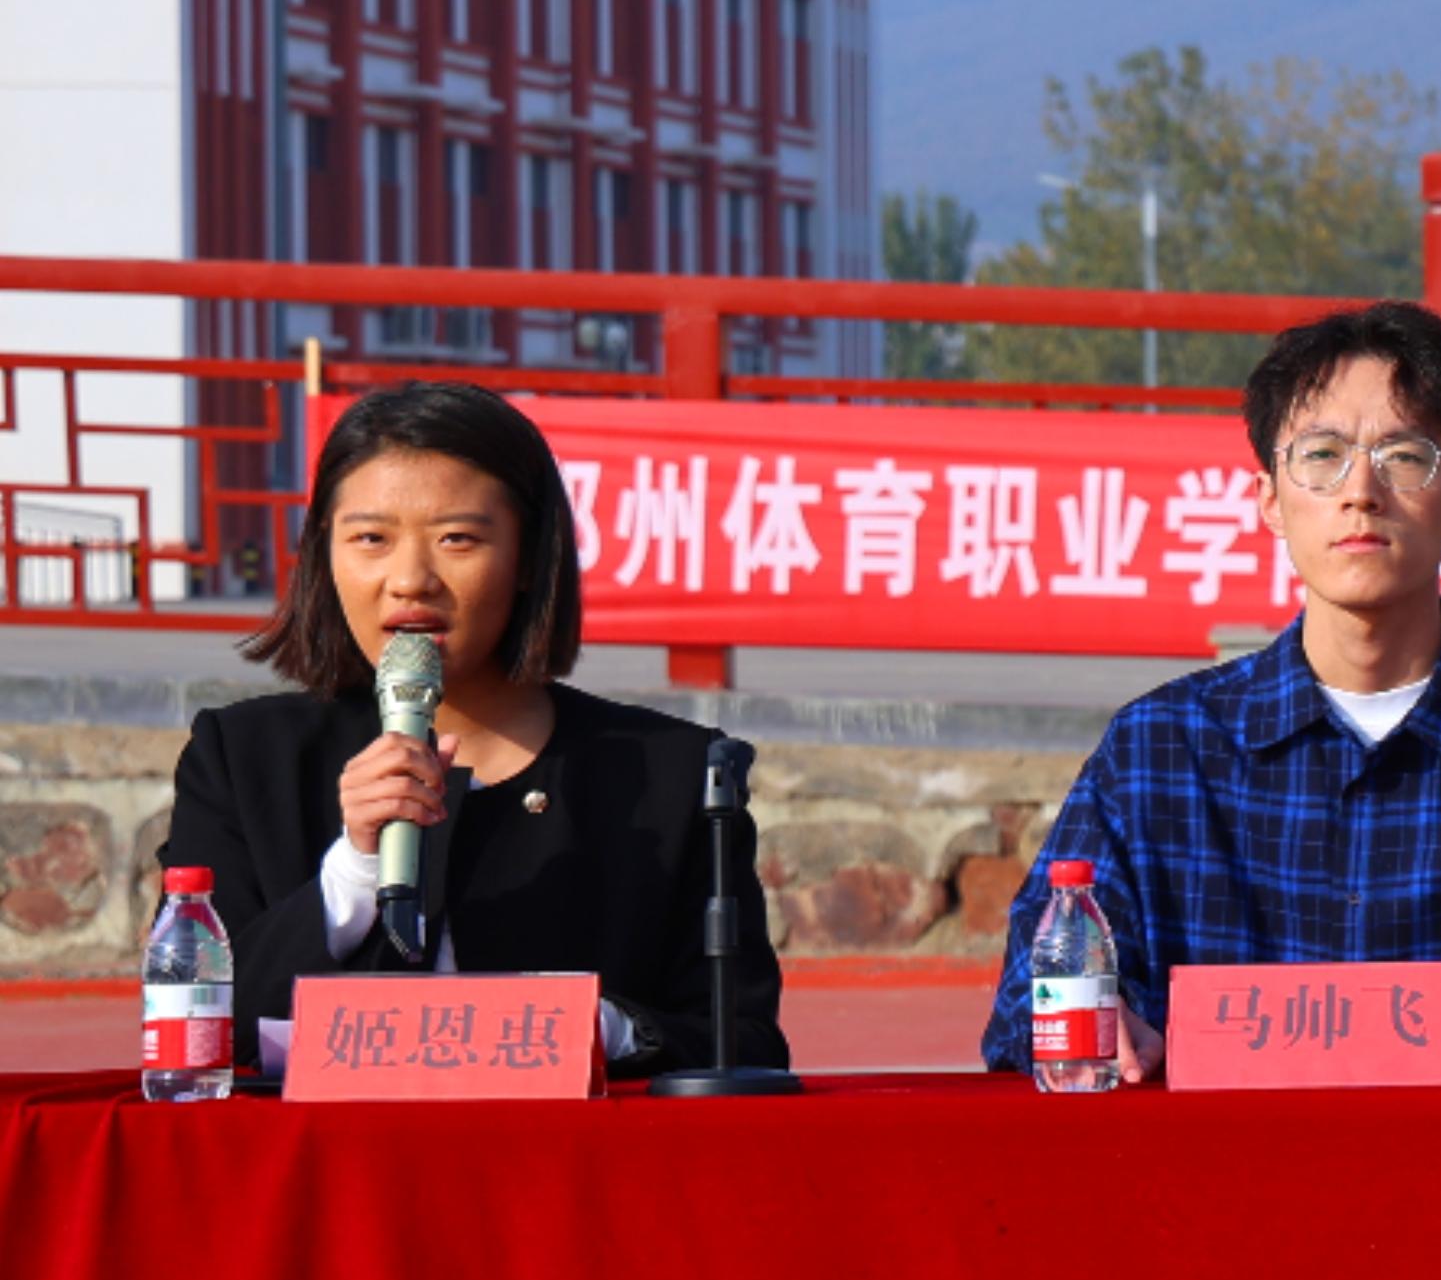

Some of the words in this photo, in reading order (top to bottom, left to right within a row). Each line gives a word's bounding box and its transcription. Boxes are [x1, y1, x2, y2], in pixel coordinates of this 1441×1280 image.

[320, 1003, 566, 1070] 姬恩惠
[1200, 983, 1429, 1051] 马帅飞
